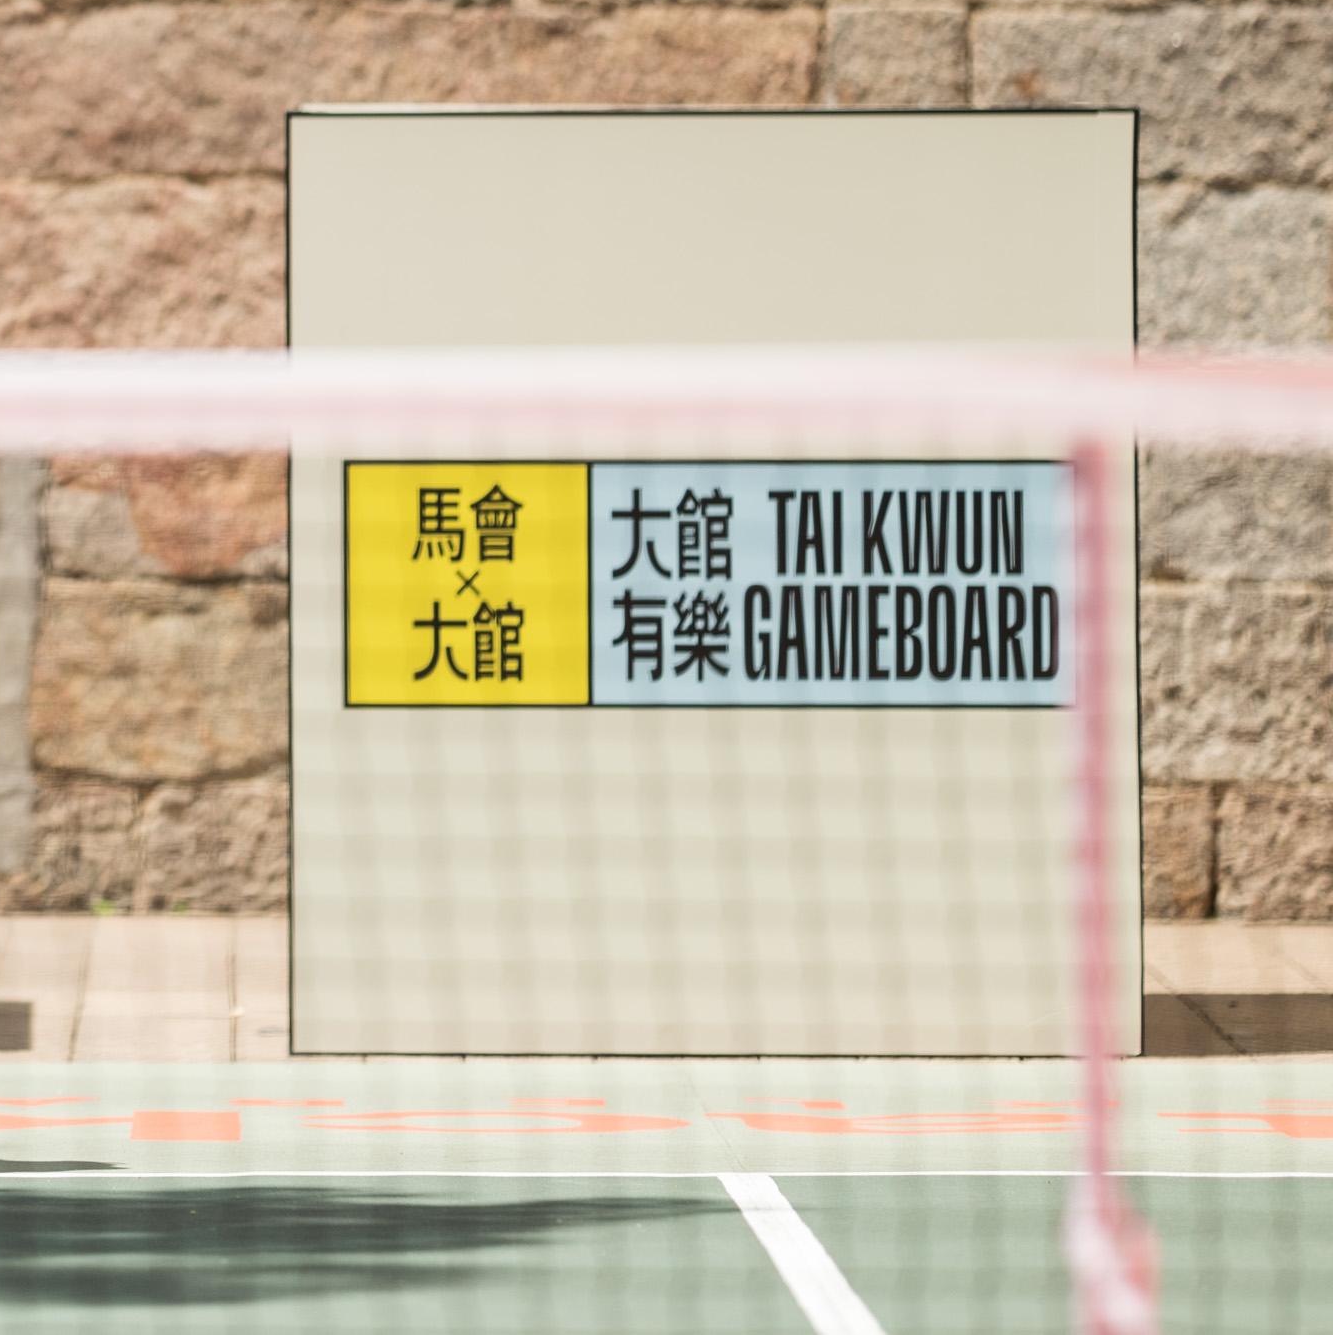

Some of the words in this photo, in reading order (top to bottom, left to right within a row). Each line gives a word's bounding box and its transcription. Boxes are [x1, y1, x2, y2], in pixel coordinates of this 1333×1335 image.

[413, 484, 523, 562] 馬會
[612, 488, 733, 580] 大館
[768, 490, 842, 575] TAI
[863, 490, 1023, 575] KWUN
[413, 601, 524, 681] 大館
[613, 589, 730, 682] 有樂
[744, 585, 1058, 681] GAMEBOARD
